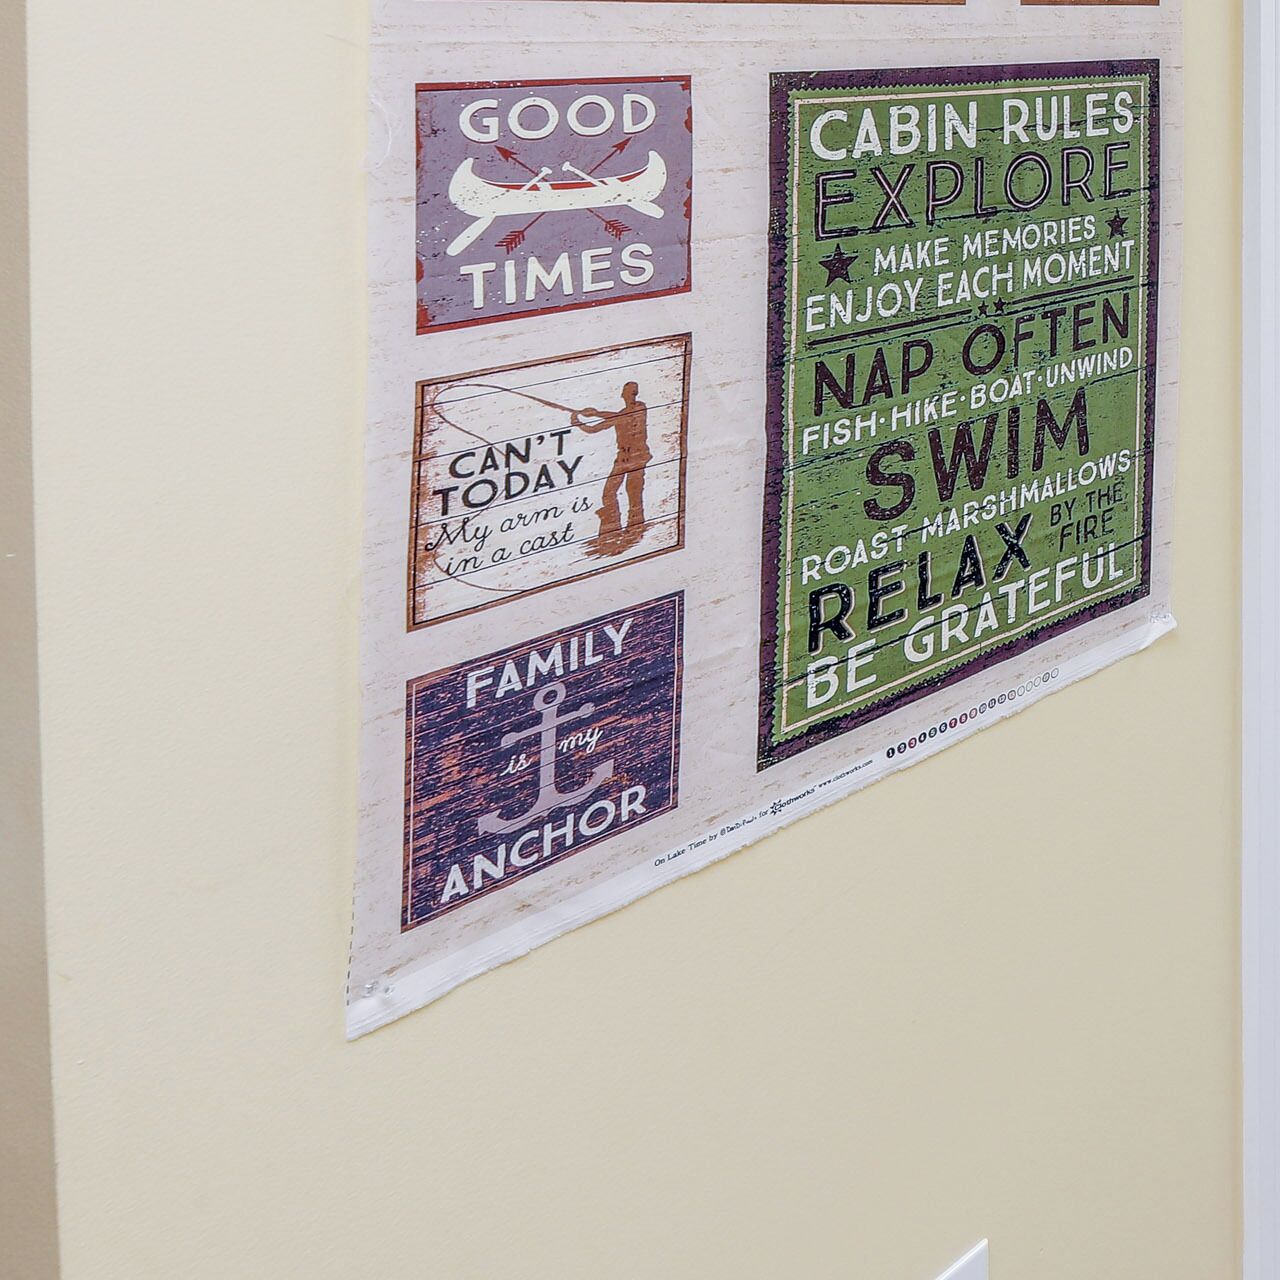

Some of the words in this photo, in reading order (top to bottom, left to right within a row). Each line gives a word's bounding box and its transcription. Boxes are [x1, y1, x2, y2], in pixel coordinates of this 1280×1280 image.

[458, 93, 657, 144] GOOD
[809, 100, 978, 161] CABIN
[1002, 91, 1134, 145] RULES
[815, 141, 1131, 242] EXPLORE
[460, 243, 655, 309] TIMES
[873, 237, 950, 276] MAKE
[962, 215, 1096, 262] MEMORIES
[805, 277, 923, 332] ENJOY
[937, 262, 1014, 308] EACH
[1022, 240, 1136, 290] MOMENT
[813, 338, 934, 417] NAP
[962, 292, 1131, 376] OFTEN
[433, 455, 584, 517] TODAY
[449, 429, 572, 479] CAN'T
[863, 386, 1091, 522] SWIM
[425, 517, 493, 552] My
[500, 505, 564, 533] arm
[571, 496, 594, 514] is
[801, 524, 909, 585] ROAST
[921, 449, 1132, 545] MARSHMALLOWS
[1050, 500, 1077, 527] BY
[1086, 482, 1125, 514] THE
[1059, 508, 1116, 552] FIRE
[446, 555, 484, 576] in
[491, 548, 513, 563] a
[519, 522, 575, 555] cast
[808, 512, 1035, 656] RELAX
[806, 638, 878, 709] BE
[903, 543, 1125, 664] GRATEFUL
[466, 618, 634, 709] FAMILY
[500, 752, 533, 776] is
[558, 728, 605, 754] my
[439, 784, 648, 904] ANCHOR
[654, 858, 665, 867] On
[667, 848, 686, 861] Lake
[688, 839, 706, 851] Time
[708, 833, 719, 842] by
[759, 809, 769, 818] for
